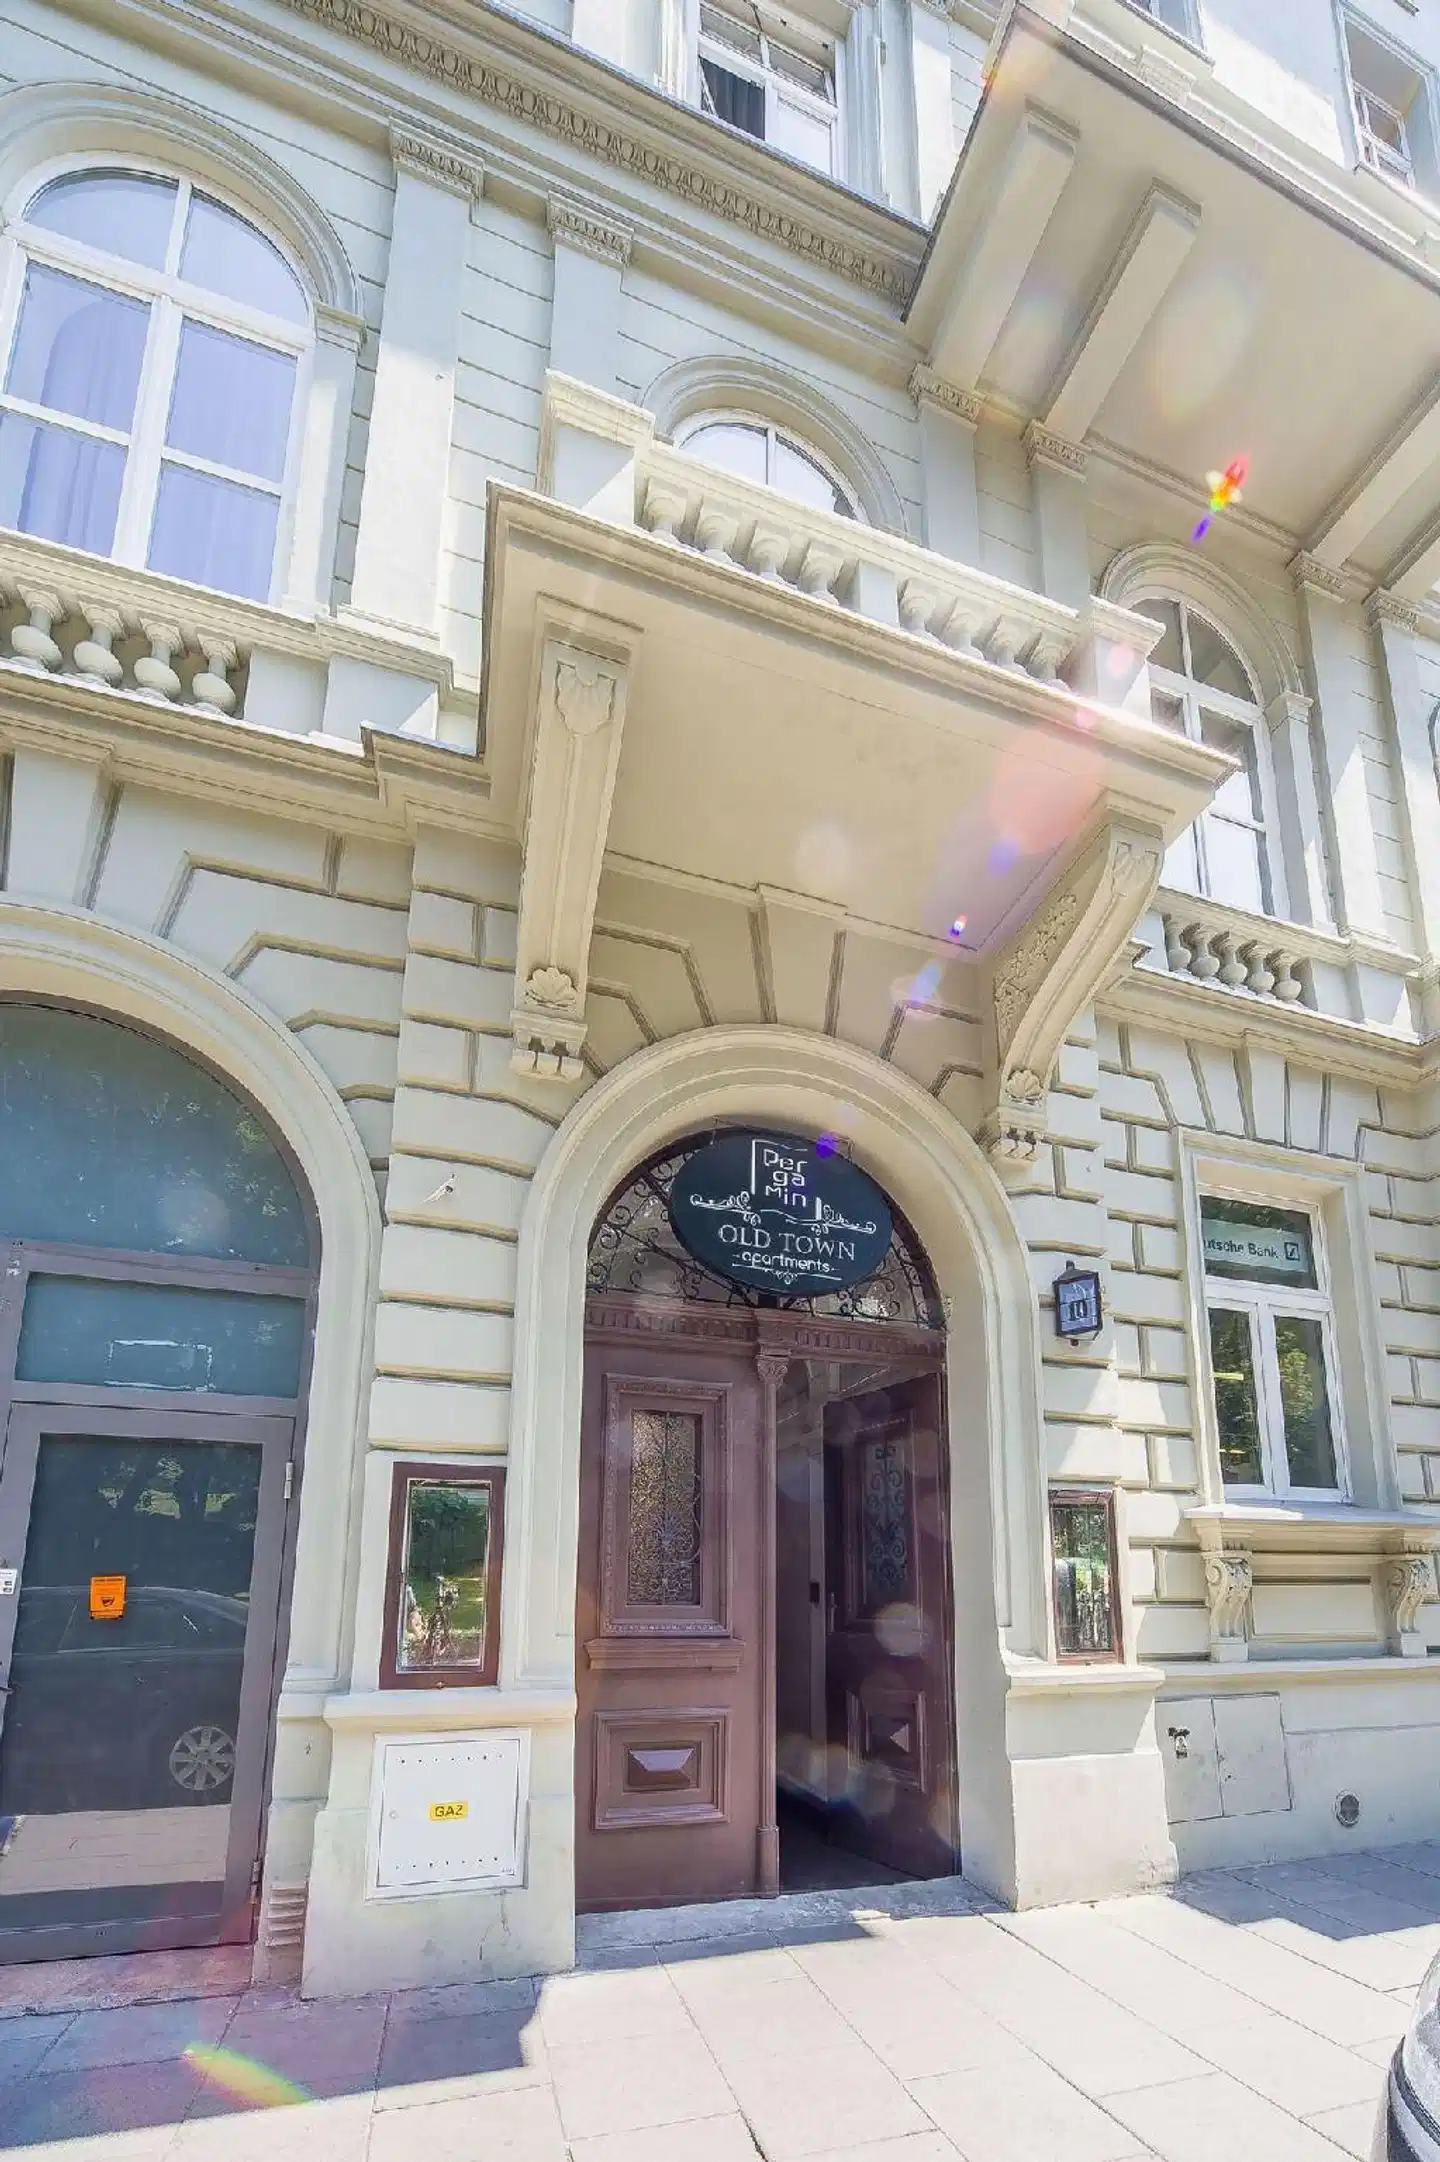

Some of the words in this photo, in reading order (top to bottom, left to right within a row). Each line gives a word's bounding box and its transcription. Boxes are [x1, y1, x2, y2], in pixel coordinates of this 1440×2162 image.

[764, 1148, 808, 1172] Per
[773, 1170, 805, 1187] ga
[718, 1224, 772, 1249] OLD
[779, 1233, 855, 1260] TOWN
[1068, 1299, 1088, 1321] 10
[434, 1804, 463, 1817] GAZ
